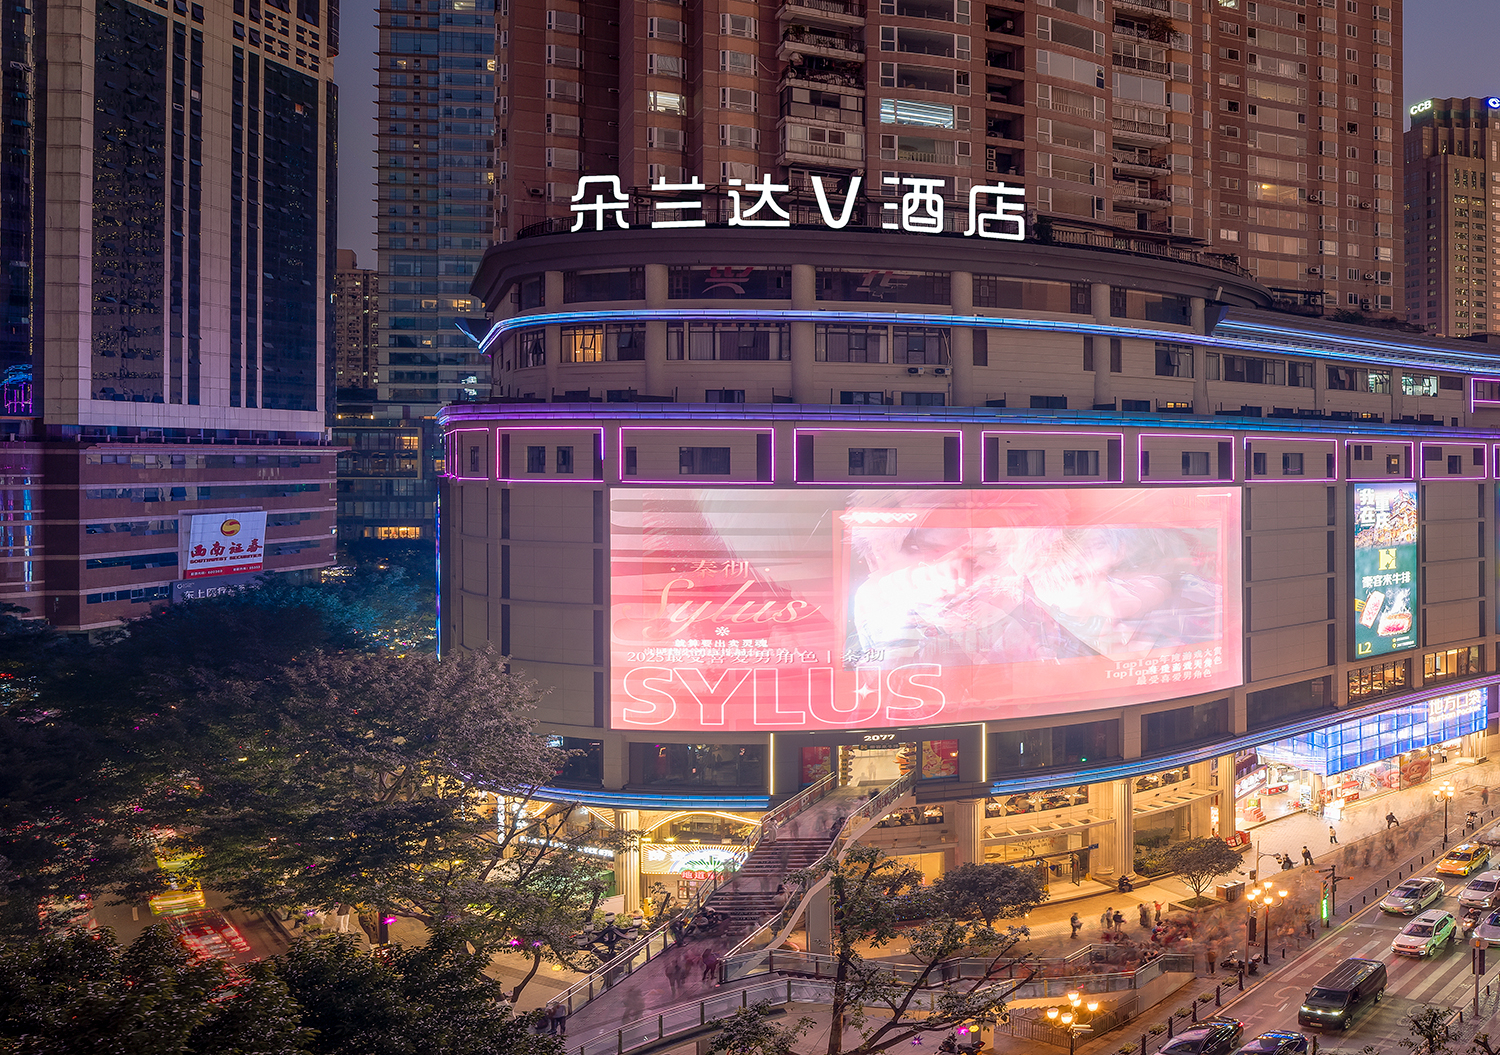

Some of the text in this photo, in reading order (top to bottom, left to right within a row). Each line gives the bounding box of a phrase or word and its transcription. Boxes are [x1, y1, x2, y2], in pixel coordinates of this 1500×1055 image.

[1409, 99, 1433, 115] CCB
[570, 173, 1026, 241] 朵兰达V酒店
[190, 538, 262, 558] 西南证券
[622, 577, 822, 642] Sylus
[1358, 641, 1372, 654] L2
[622, 662, 946, 726] SYLUS
[863, 733, 896, 742] 2077
